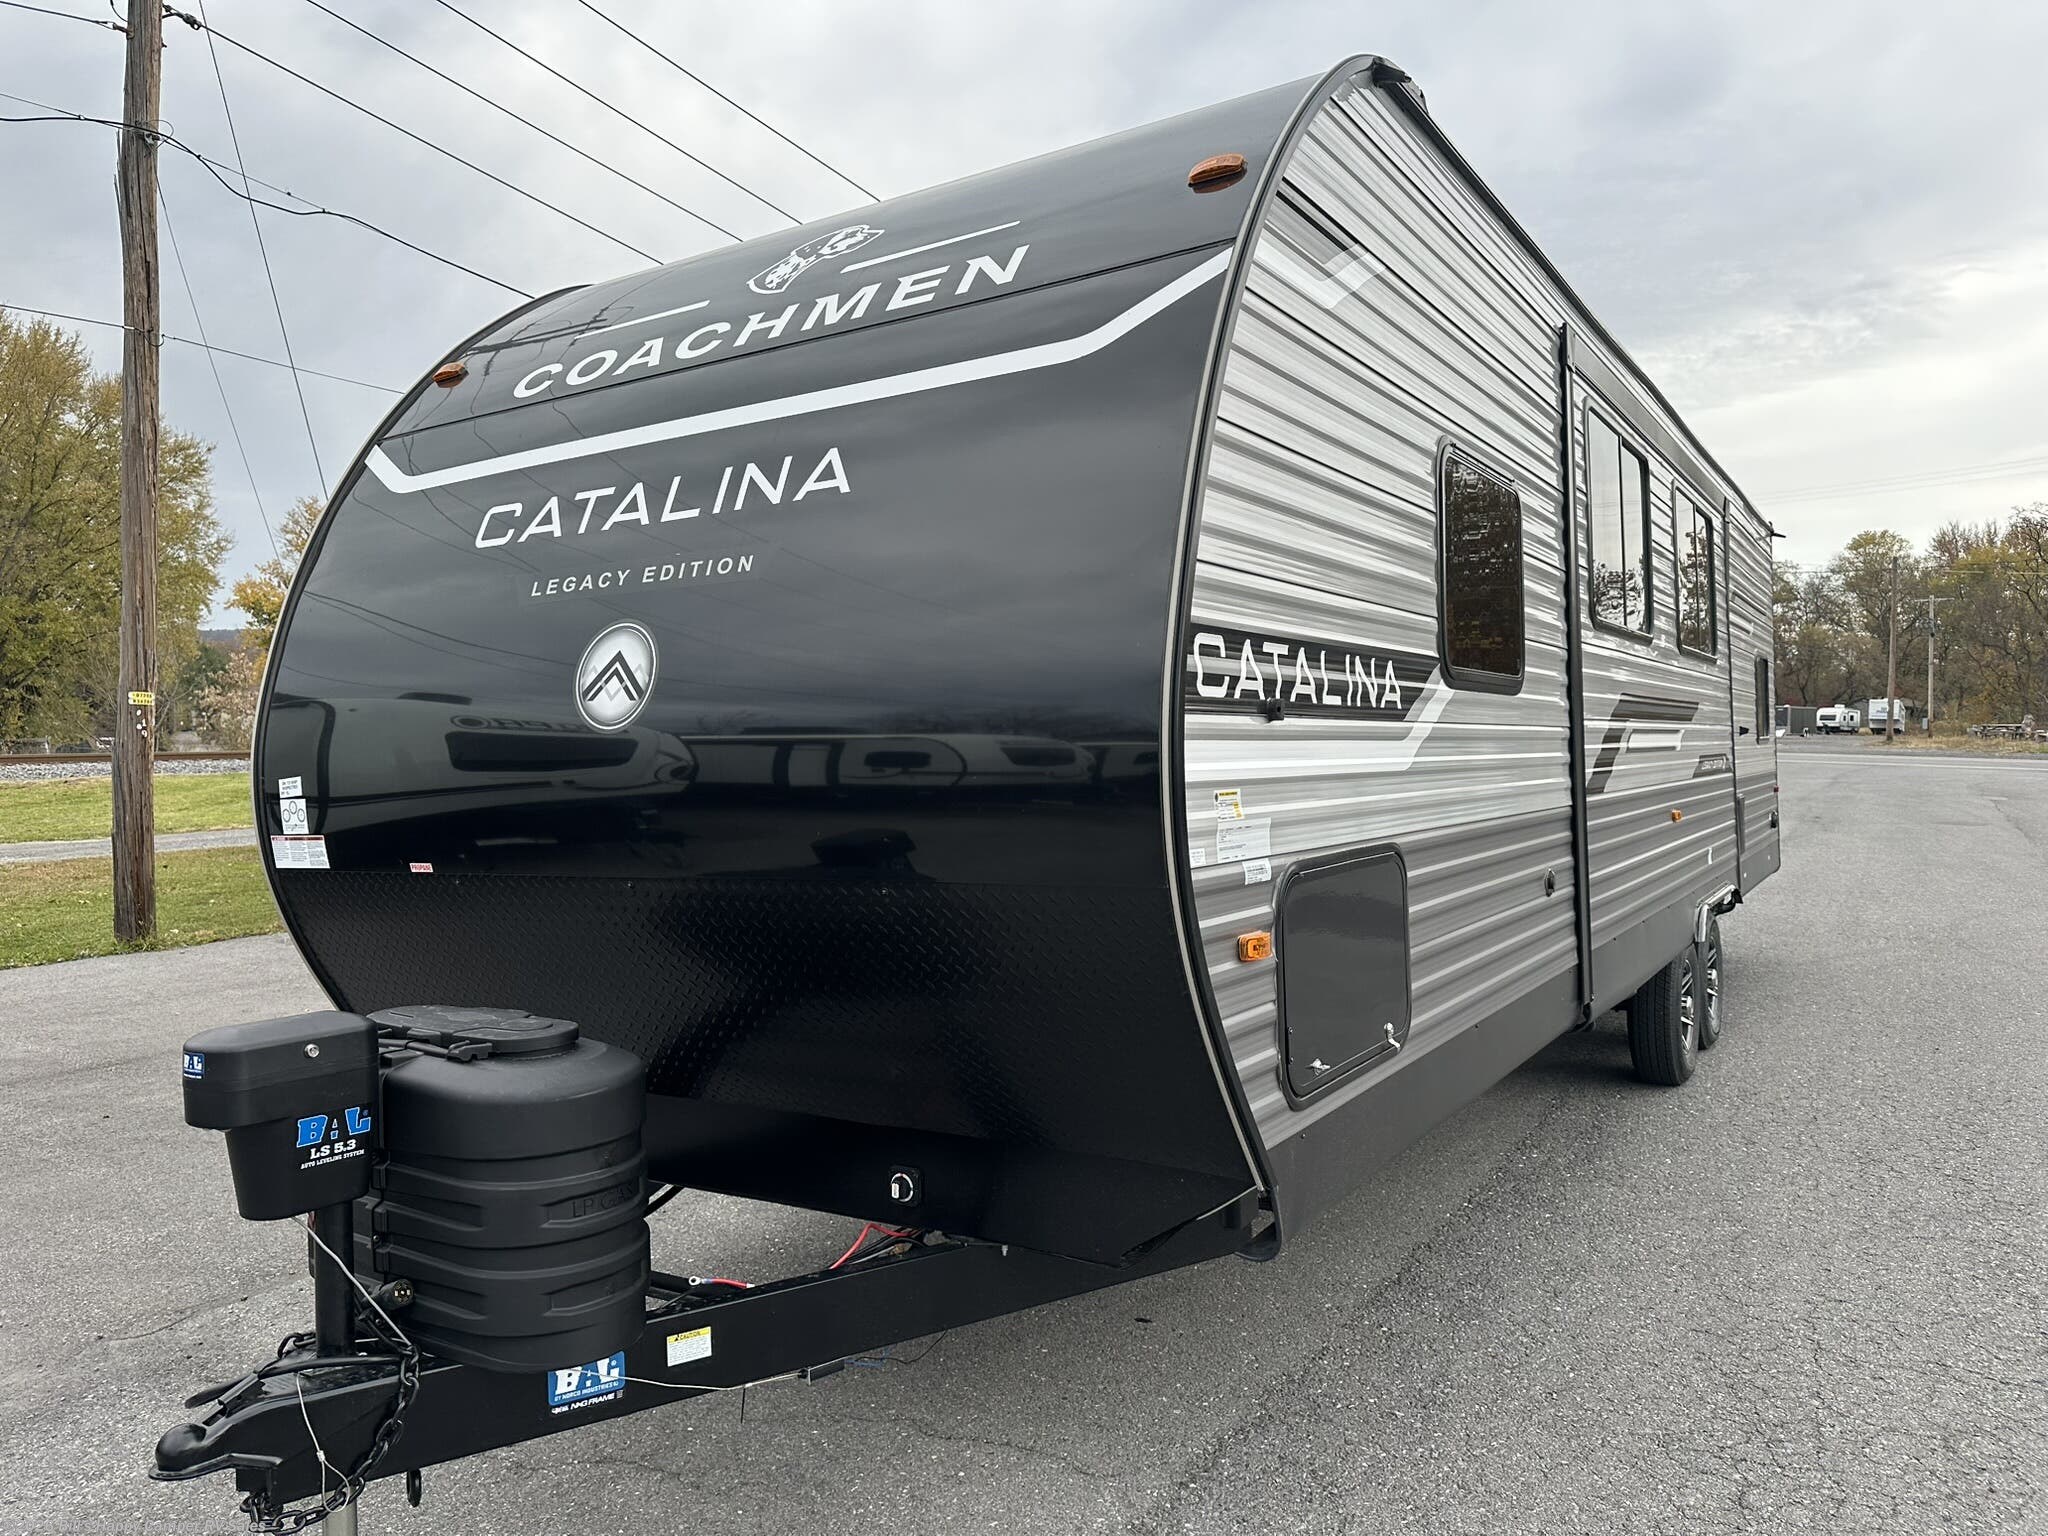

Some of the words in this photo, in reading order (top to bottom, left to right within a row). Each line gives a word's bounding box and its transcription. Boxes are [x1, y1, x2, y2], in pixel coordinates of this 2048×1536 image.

[513, 244, 1030, 399] COACHMEN
[475, 447, 851, 548] CATALINA
[531, 569, 631, 597] LEGACY
[642, 555, 754, 583] EDITION
[1194, 632, 1402, 709] CATALINA
[300, 1160, 316, 1169] AUTO
[343, 1149, 365, 1159] SYSTEM
[310, 1145, 330, 1159] LS
[334, 1139, 356, 1153] 5.3
